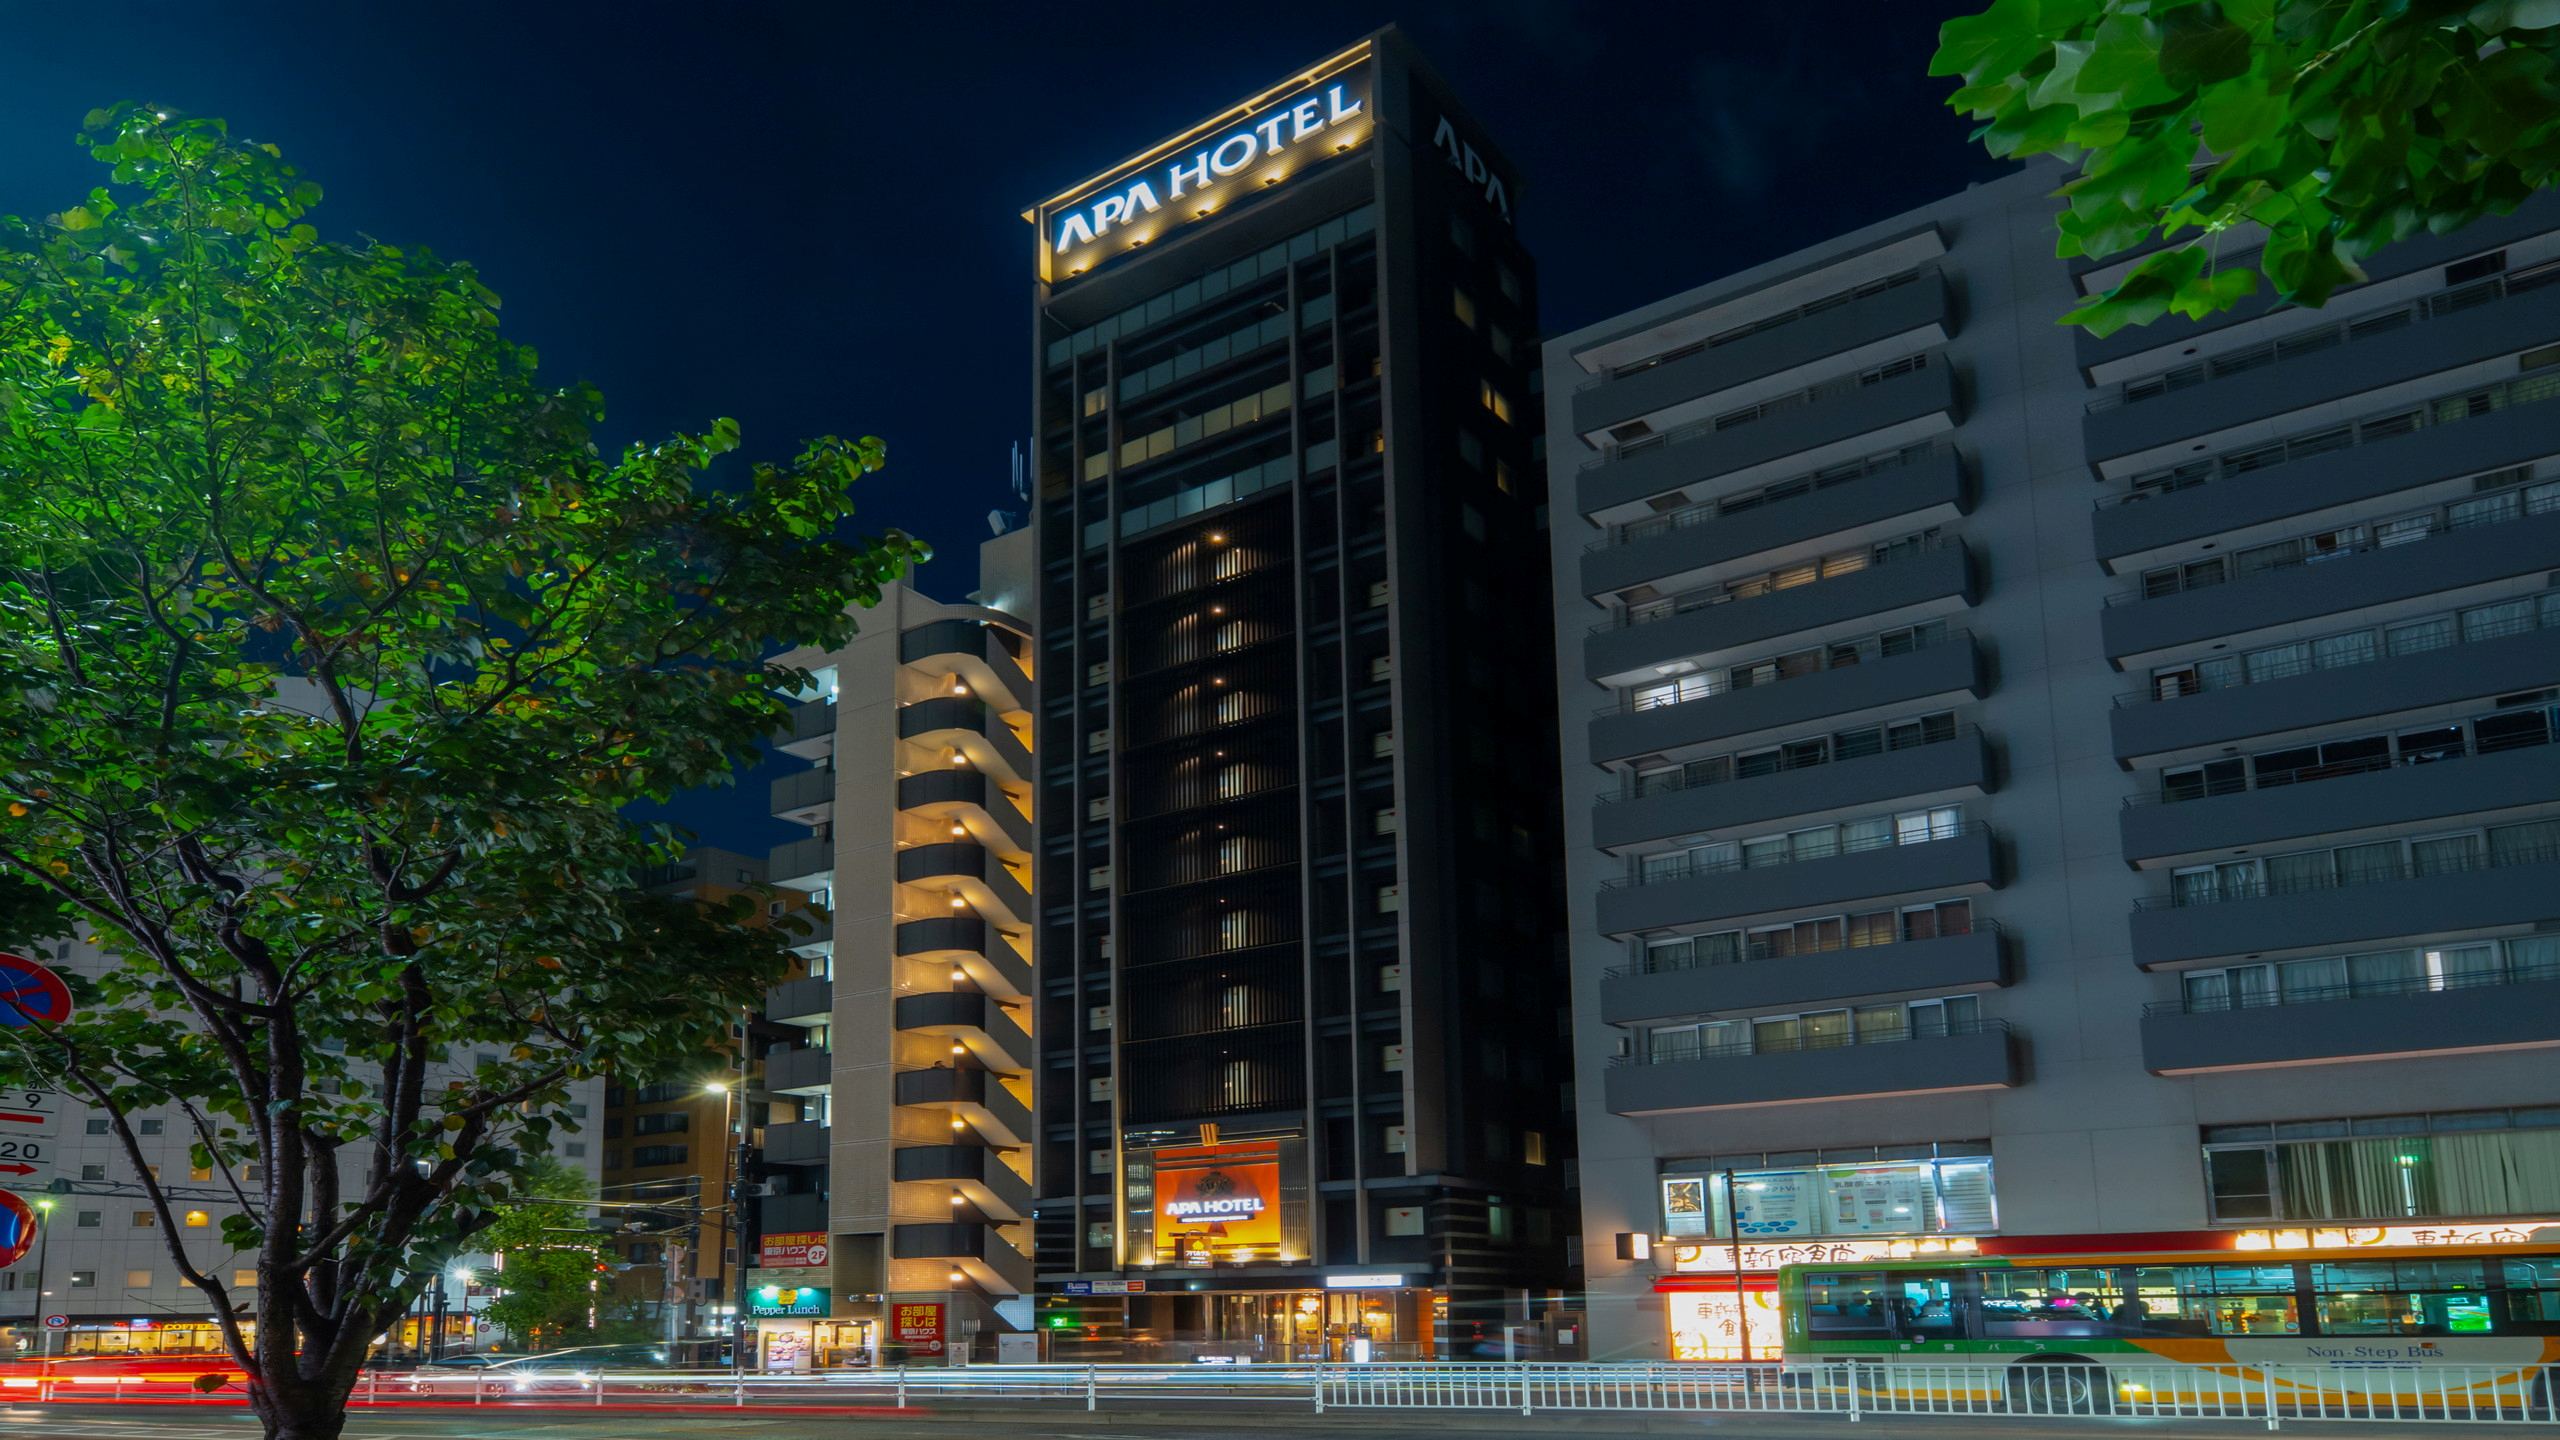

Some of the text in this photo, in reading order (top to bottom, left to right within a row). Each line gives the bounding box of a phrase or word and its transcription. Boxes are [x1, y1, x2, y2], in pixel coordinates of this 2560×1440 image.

[1056, 85, 1361, 255] APA HOTEL
[1433, 113, 1511, 225] APA
[1166, 1198, 1264, 1215] APA HOTEL
[811, 1250, 825, 1260] 2F
[752, 1305, 820, 1316] Pepper Lunch
[2307, 1345, 2444, 1359] Non-Step Bus
